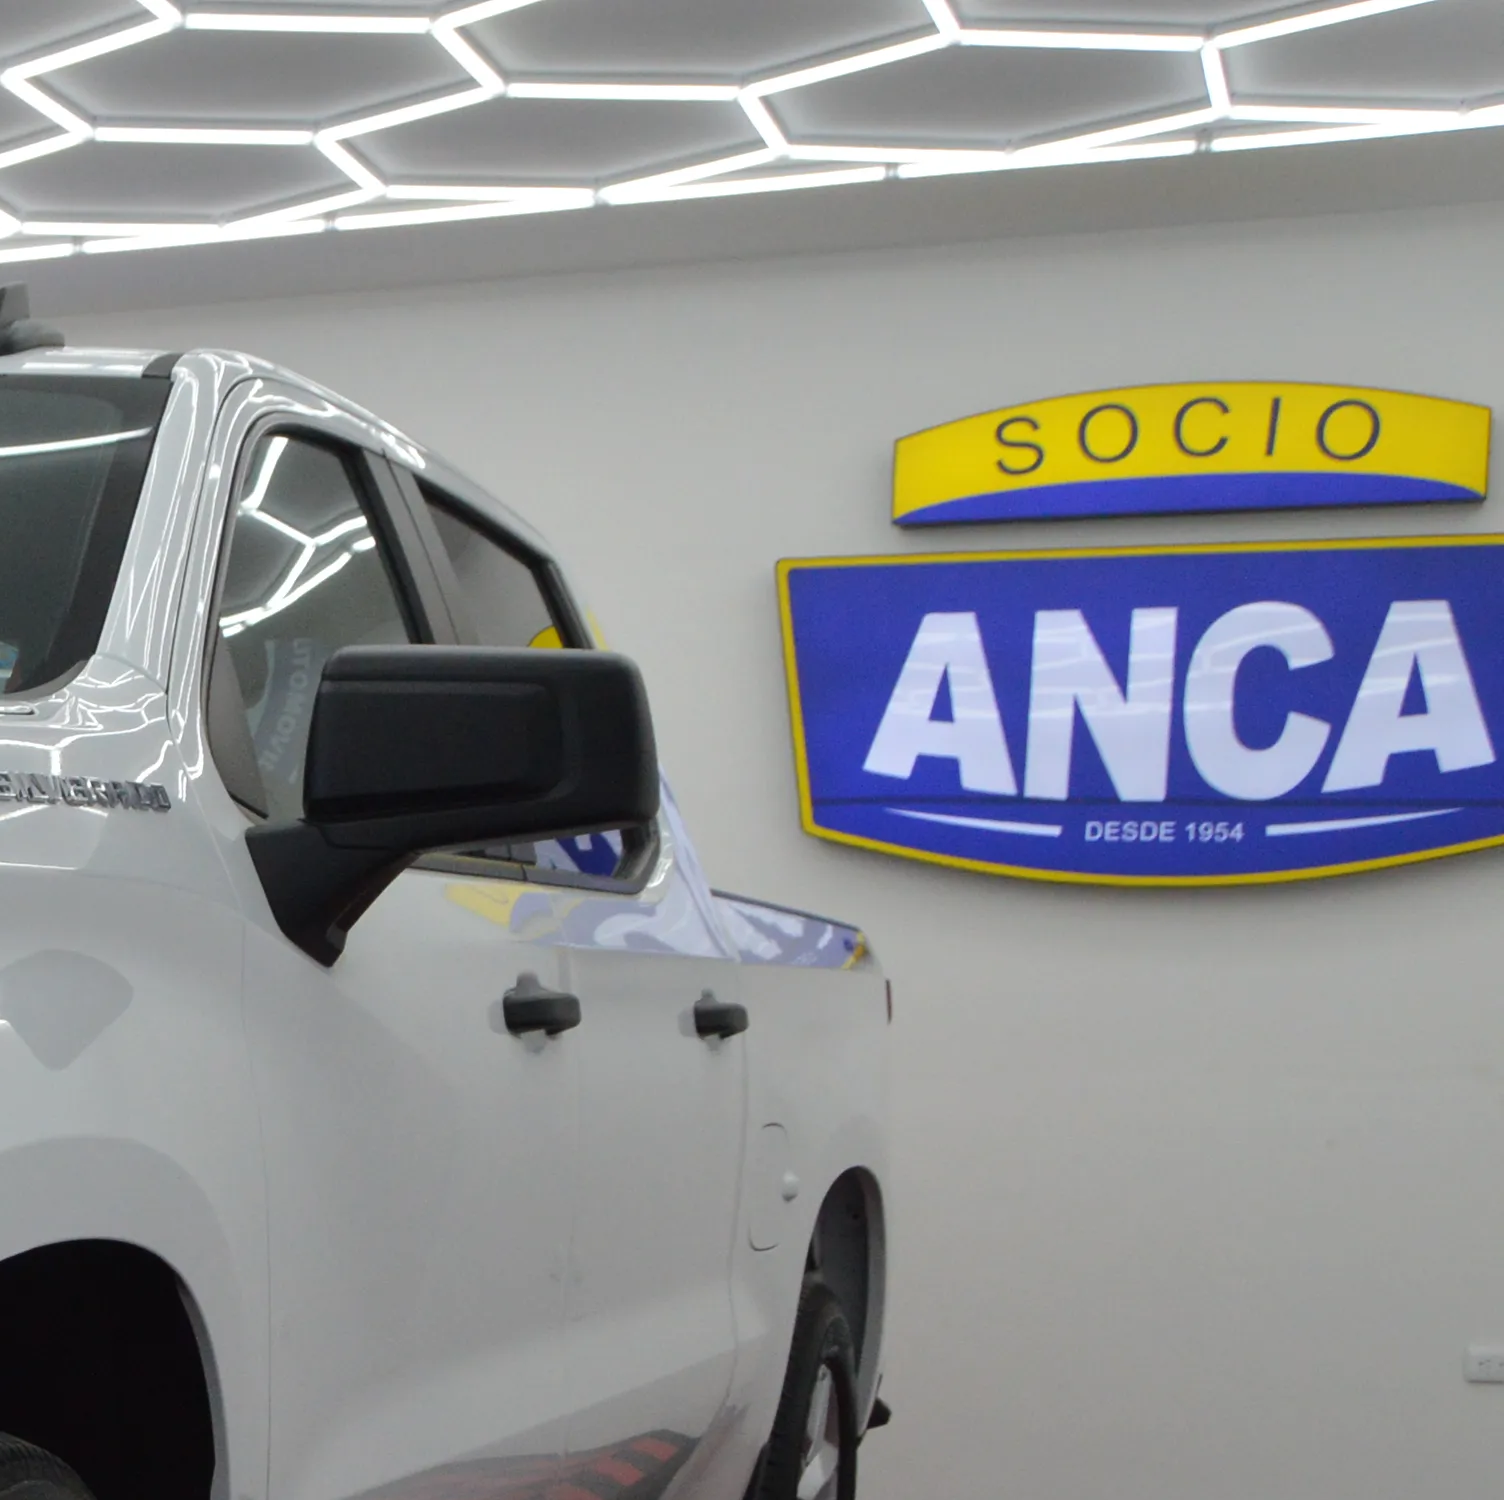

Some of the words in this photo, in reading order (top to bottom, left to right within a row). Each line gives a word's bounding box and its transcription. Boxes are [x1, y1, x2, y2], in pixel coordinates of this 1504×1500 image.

[995, 396, 1382, 475] SOCIO
[862, 599, 1497, 803] ANCA
[1084, 819, 1176, 843] DESDE
[1184, 819, 1246, 843] 1954
